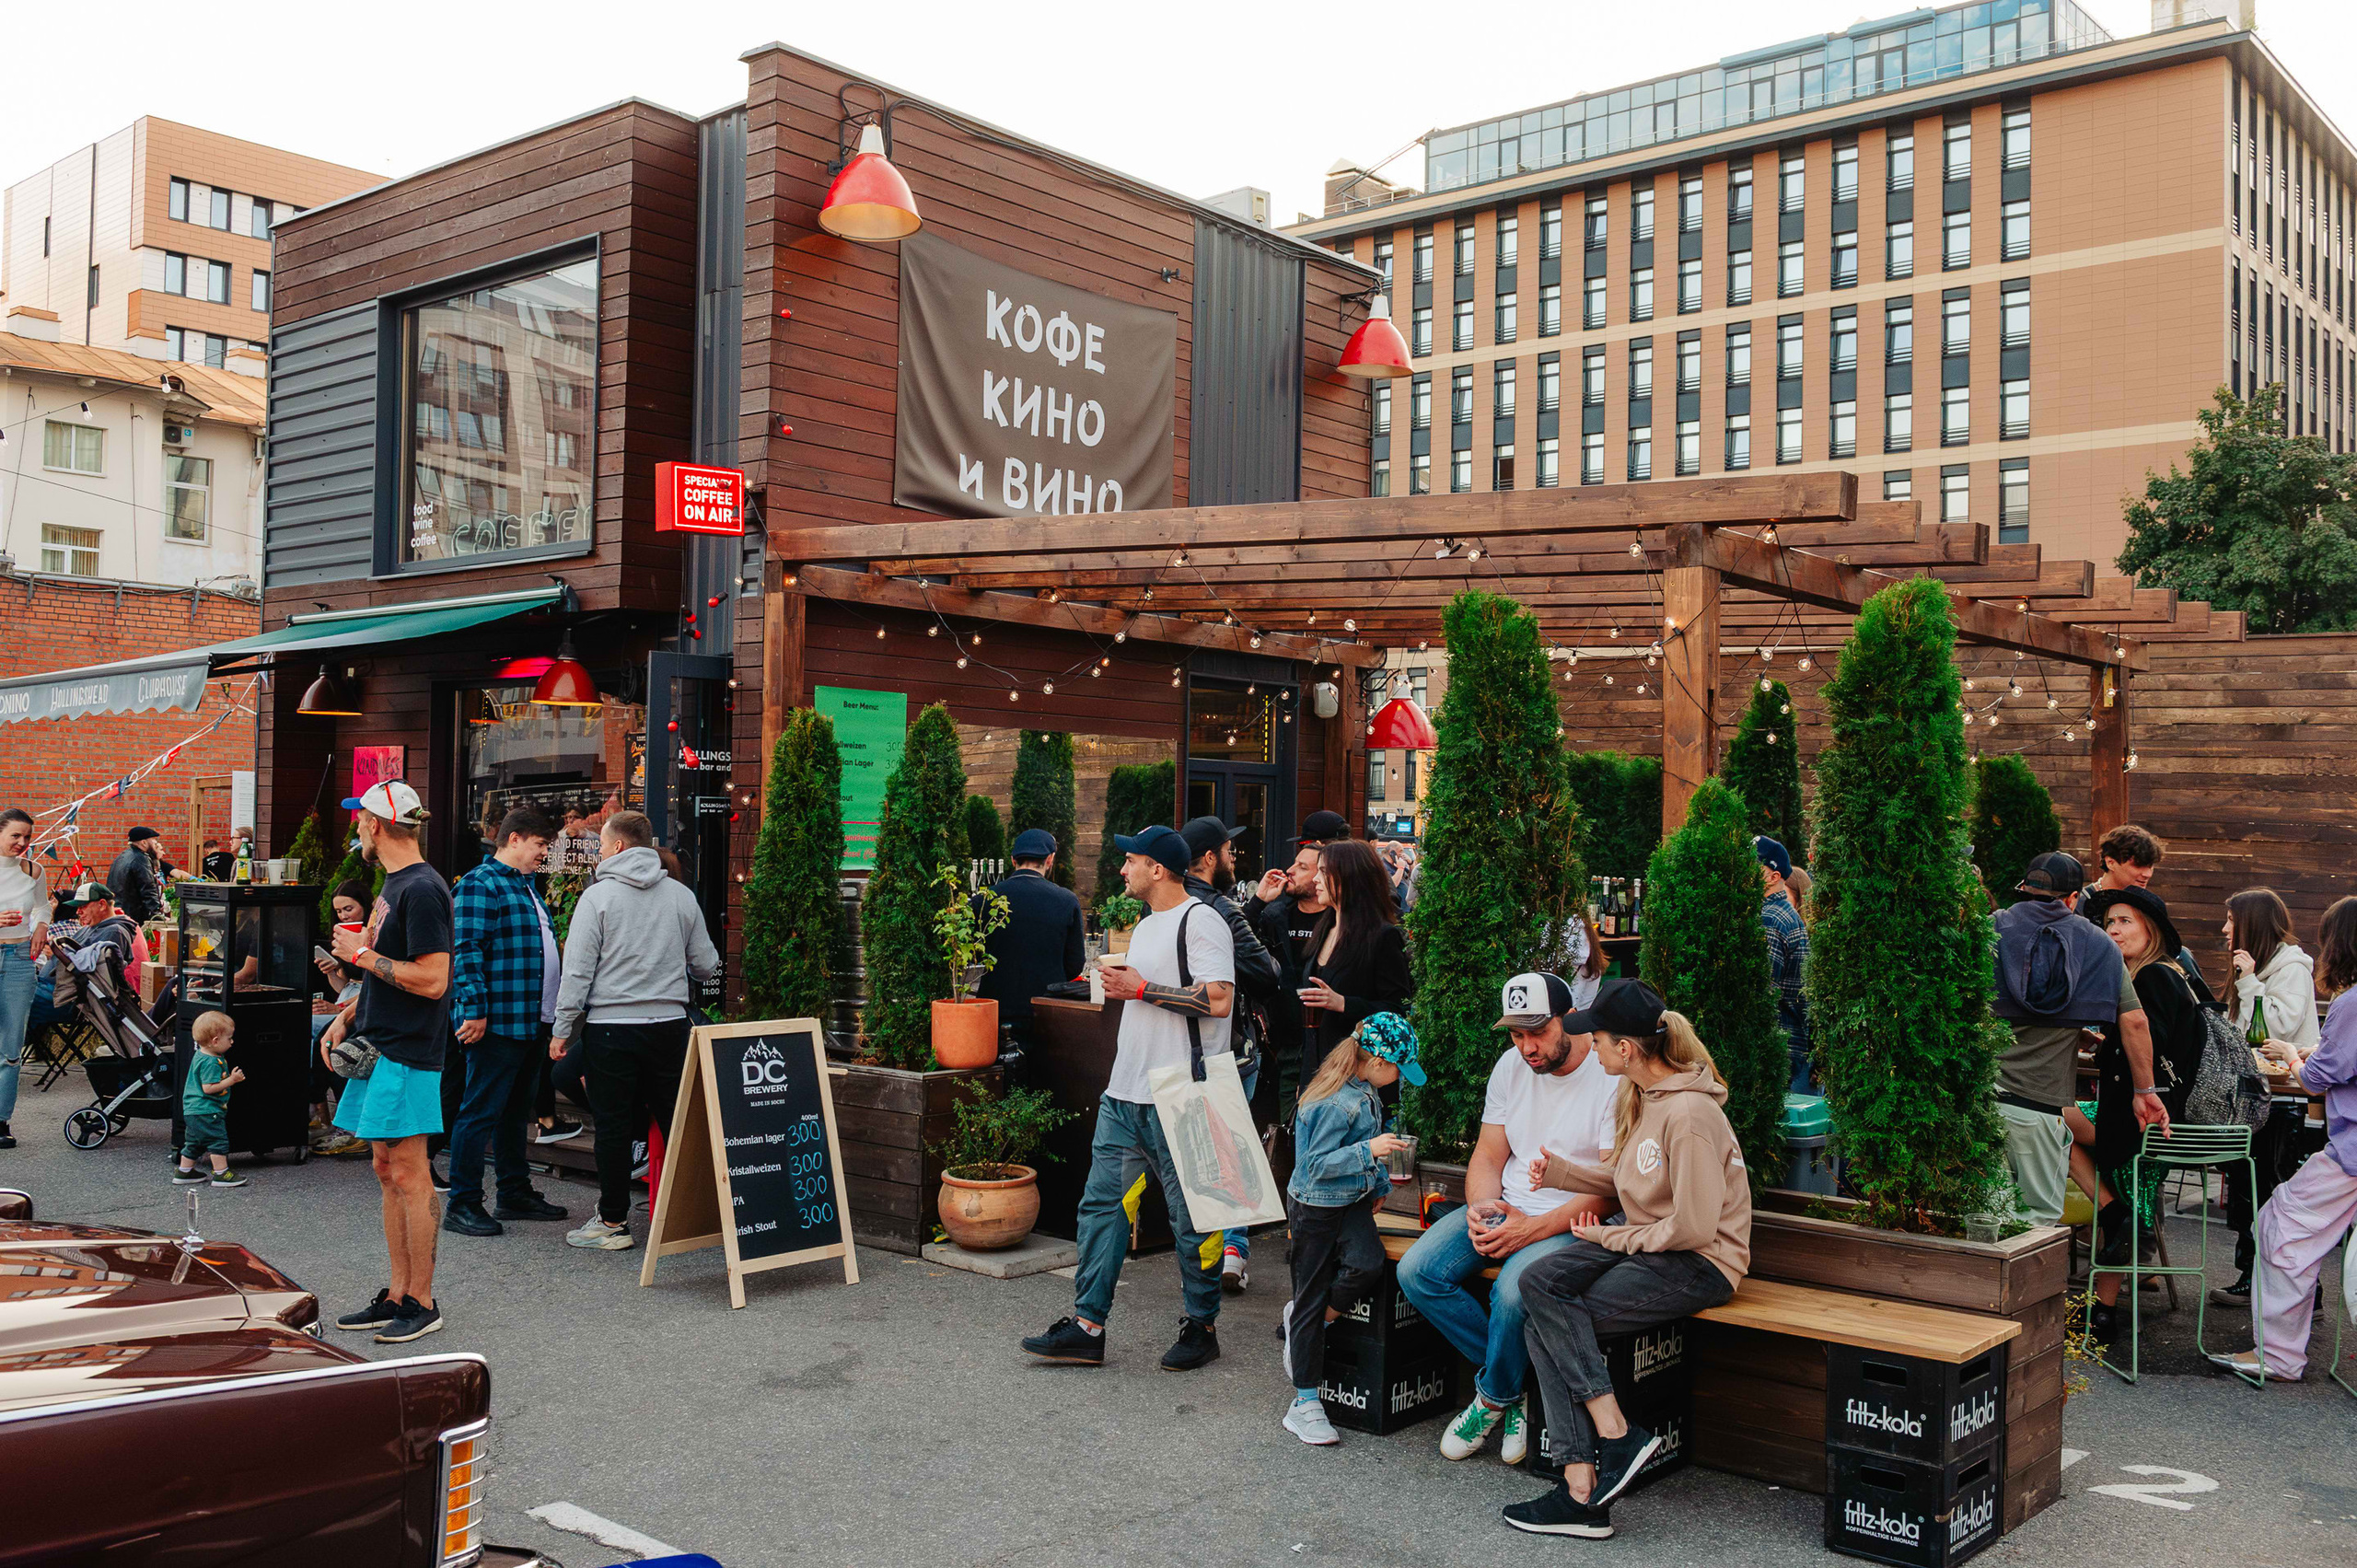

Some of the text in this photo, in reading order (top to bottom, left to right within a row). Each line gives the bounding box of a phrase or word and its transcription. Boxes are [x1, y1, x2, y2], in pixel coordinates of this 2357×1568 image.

[987, 289, 1105, 375] КОФЕ
[983, 369, 1105, 447] КИНО
[684, 475, 733, 489] SPECIAY
[1003, 457, 1122, 516] ВИНО
[684, 487, 733, 506] COFFEE
[413, 502, 434, 517] food
[684, 504, 733, 523] ON AIR
[412, 517, 434, 530] wine
[411, 533, 437, 548] coffee
[50, 683, 110, 712] HOLLINGSHEAD
[842, 701, 879, 711] Beer Menu:
[679, 749, 731, 761] HLLINGS
[700, 761, 714, 771] bar
[716, 763, 731, 772] and
[854, 759, 874, 769] Lager
[555, 839, 571, 848] AND
[573, 839, 602, 850] FRIEND
[578, 853, 603, 864] BLEND
[741, 1060, 787, 1086] DC
[744, 1084, 788, 1095] BREWERY
[724, 1121, 820, 1147] Bohemian lager 300
[728, 1152, 822, 1177] Kristallweizen 300
[795, 1175, 827, 1201] 300
[755, 1220, 777, 1233] Stout
[799, 1202, 833, 1228] 300
[1633, 1326, 1683, 1372] fritz-kola
[1317, 1380, 1366, 1410] ritz-kola
[1391, 1370, 1444, 1414] fritz-kola
[1846, 1399, 1922, 1437] fritz-kola
[1950, 1390, 1994, 1443] fritz-kola
[1844, 1499, 1920, 1540] fritz-kola
[1949, 1490, 1992, 1544] fritz-kola
[1845, 1525, 1919, 1547] KOFFEINHALTIGE LIMONADE
